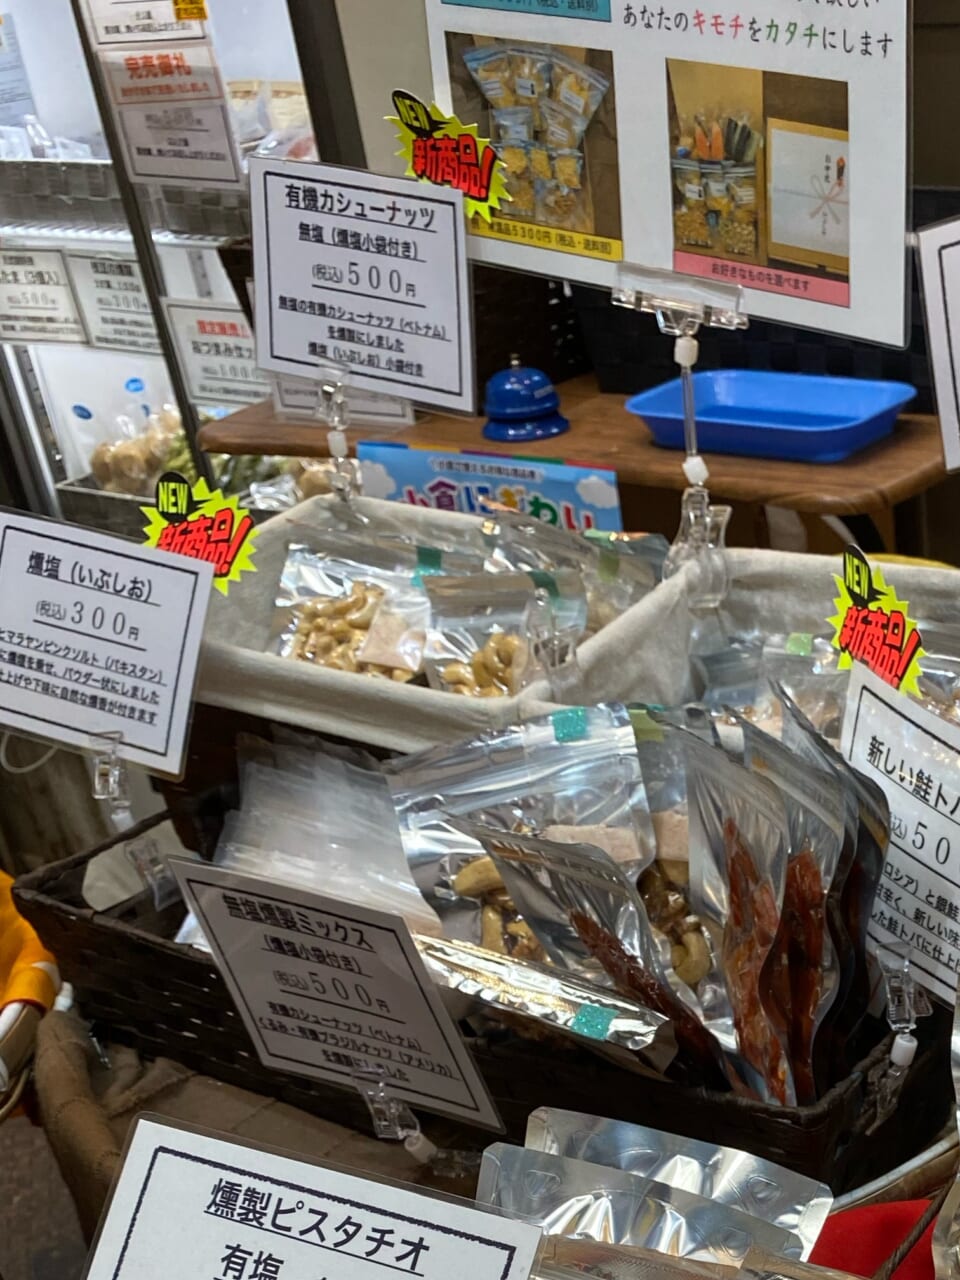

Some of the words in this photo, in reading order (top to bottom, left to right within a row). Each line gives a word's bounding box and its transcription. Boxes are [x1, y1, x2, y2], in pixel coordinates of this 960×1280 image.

[623, 3, 893, 58] あなたのキモチをカタチにします
[394, 96, 430, 131] NEW
[285, 183, 435, 229] 有機カシューナッツ
[159, 482, 188, 514] NEW
[845, 552, 869, 599] NEW
[207, 1178, 430, 1273] 燻製ピスタチオ
